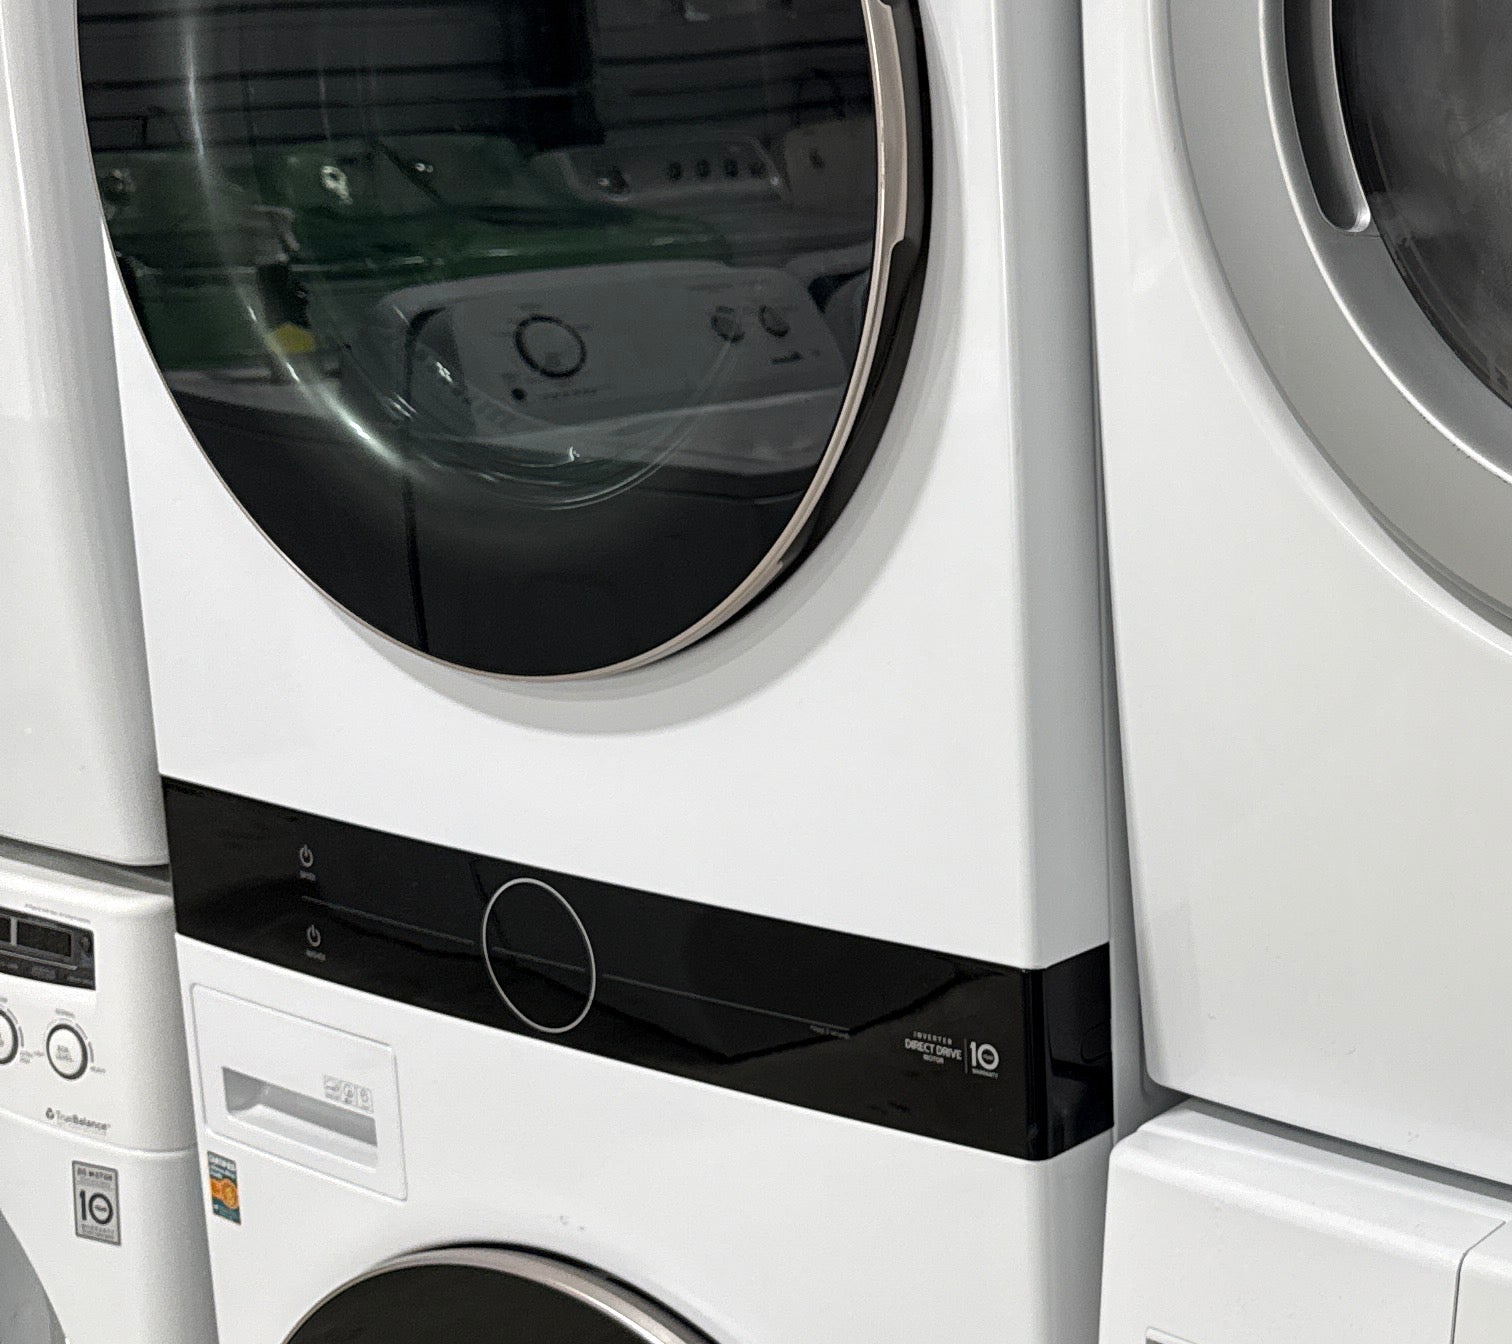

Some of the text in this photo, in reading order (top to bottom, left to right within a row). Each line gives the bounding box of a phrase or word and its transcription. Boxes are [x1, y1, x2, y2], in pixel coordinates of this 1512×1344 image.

[905, 1038, 962, 1060] DIRECT DRIVE
[79, 1190, 114, 1225] 10
